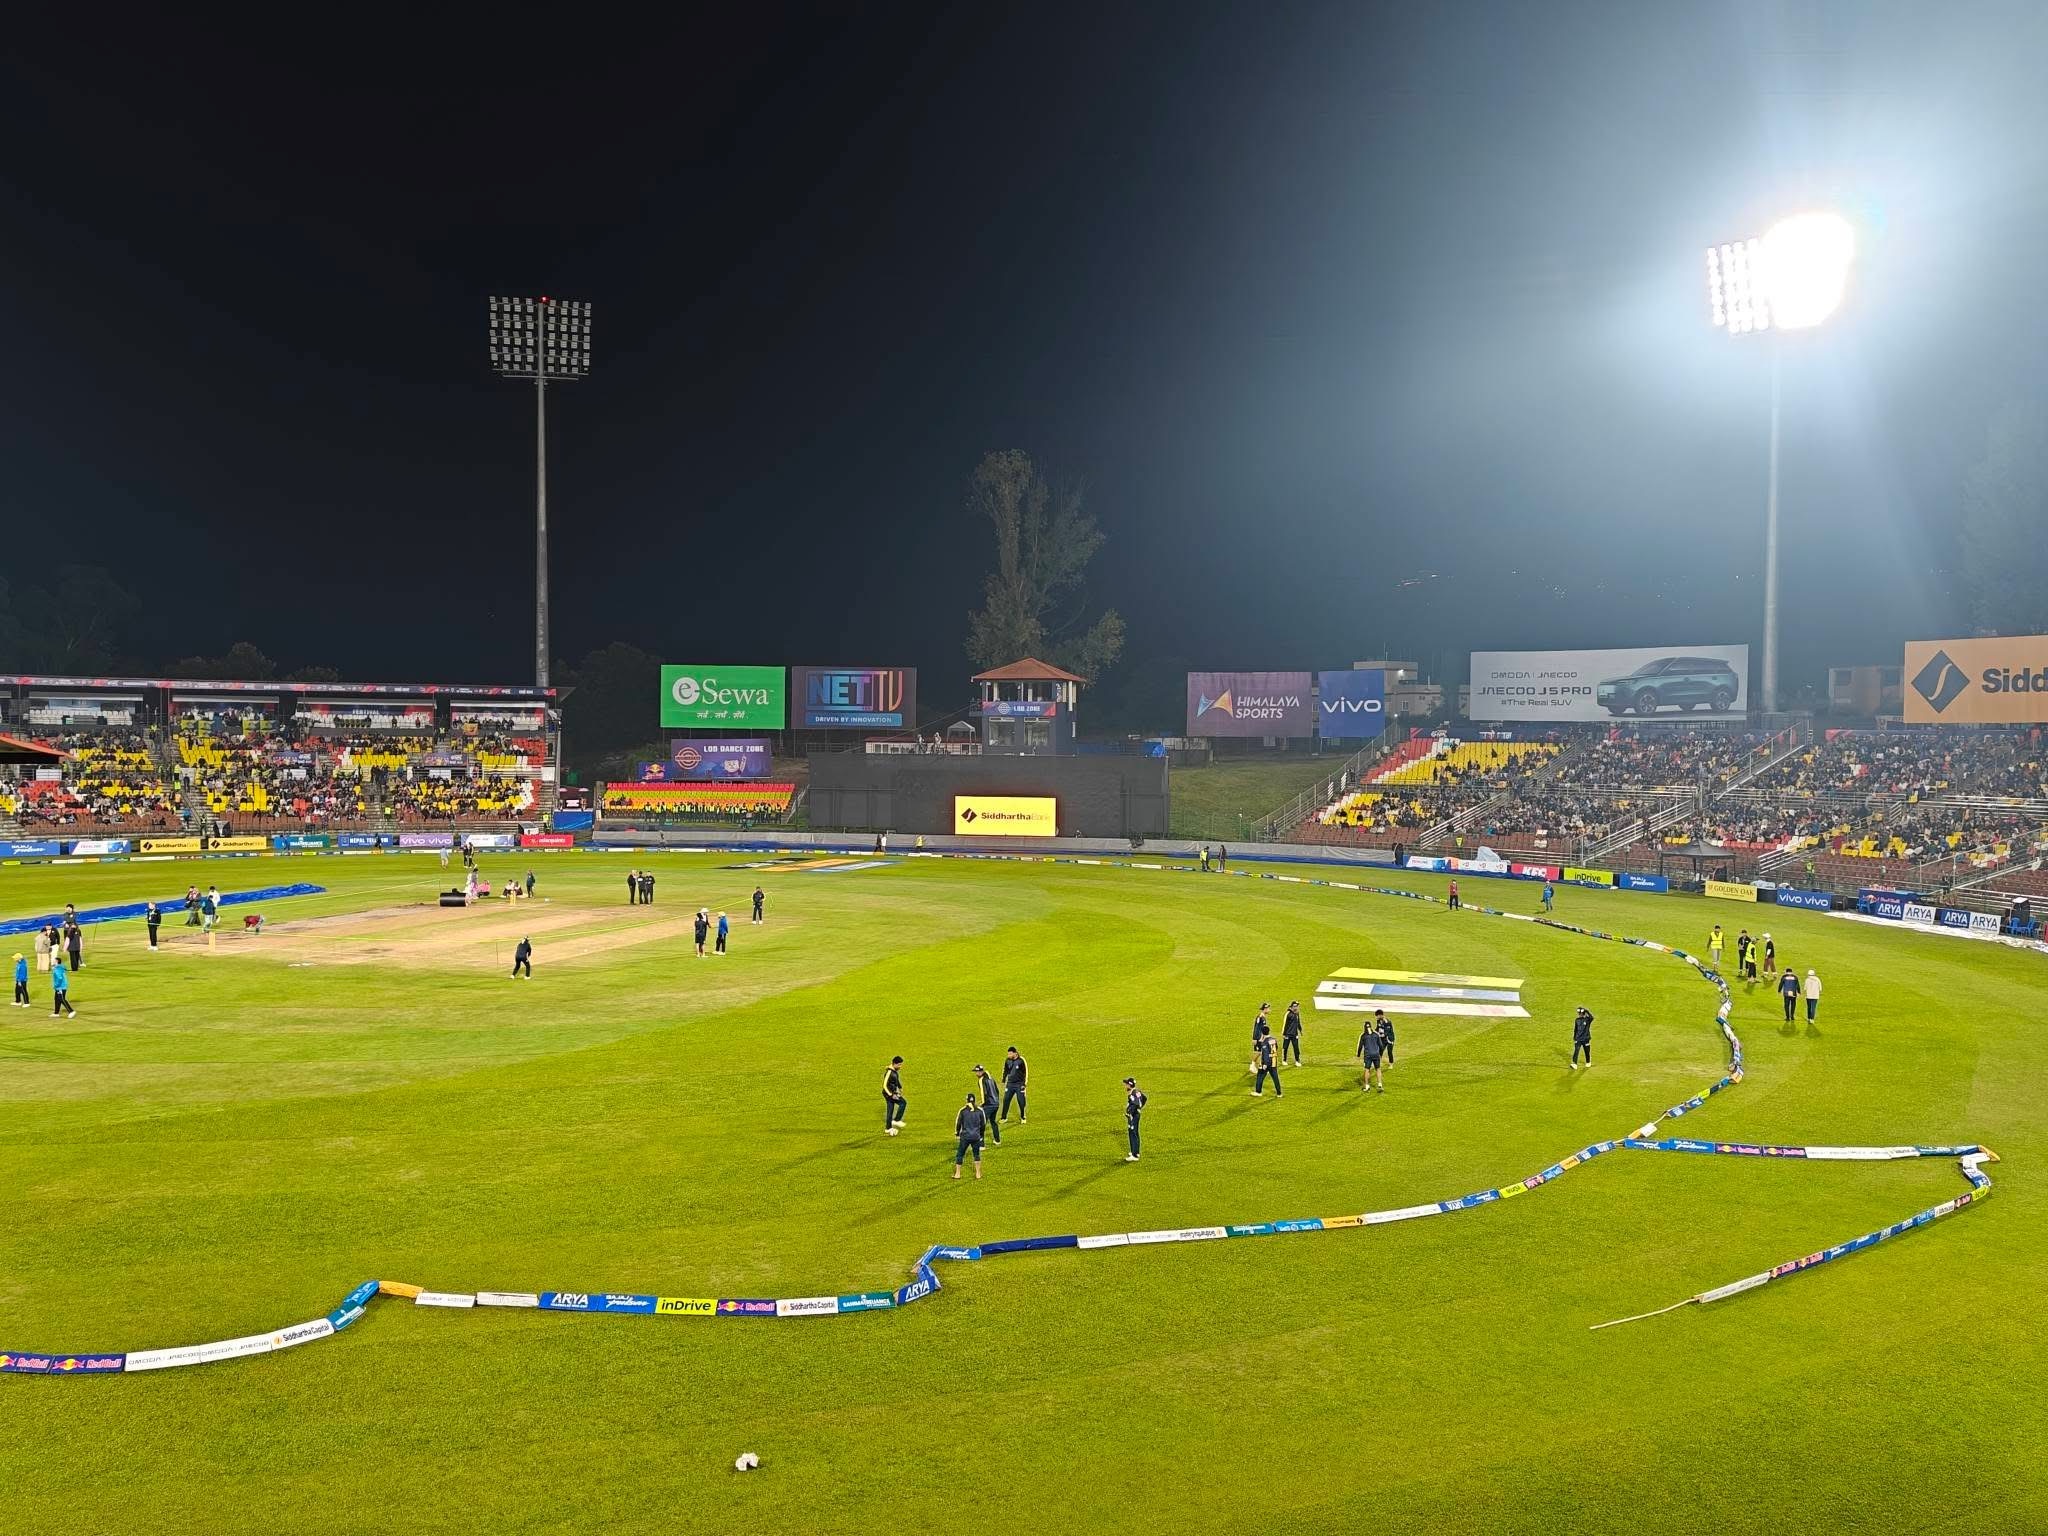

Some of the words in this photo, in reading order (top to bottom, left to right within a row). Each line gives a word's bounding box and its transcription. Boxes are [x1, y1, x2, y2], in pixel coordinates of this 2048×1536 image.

[1491, 671, 1530, 679] OMODA
[1537, 671, 1578, 679] JAECOO
[1982, 667, 2048, 693] Sidd
[808, 674, 872, 705] NET
[1478, 686, 1536, 695] JAECOO
[1561, 686, 1592, 695] PRO
[1236, 695, 1300, 708] HIMALAYA
[1322, 696, 1382, 713] vivo
[1235, 708, 1283, 719] SPORTS
[720, 745, 744, 753] DANCE
[746, 745, 764, 753] ZONE
[402, 837, 426, 845] vivo
[428, 837, 452, 845] vivo
[1522, 866, 1547, 878] KFC
[1714, 886, 1739, 894] GOLDEN
[1779, 893, 1802, 904] vivo
[1804, 895, 1829, 907] vivo
[1877, 902, 1902, 914] ARYA
[1905, 906, 1932, 919] ARYA
[1944, 911, 1968, 924] ARYA
[1972, 916, 1998, 929] ARYA
[905, 1279, 930, 1300] ARYA
[550, 1293, 589, 1304] ARYA
[661, 1300, 711, 1311] inDrive
